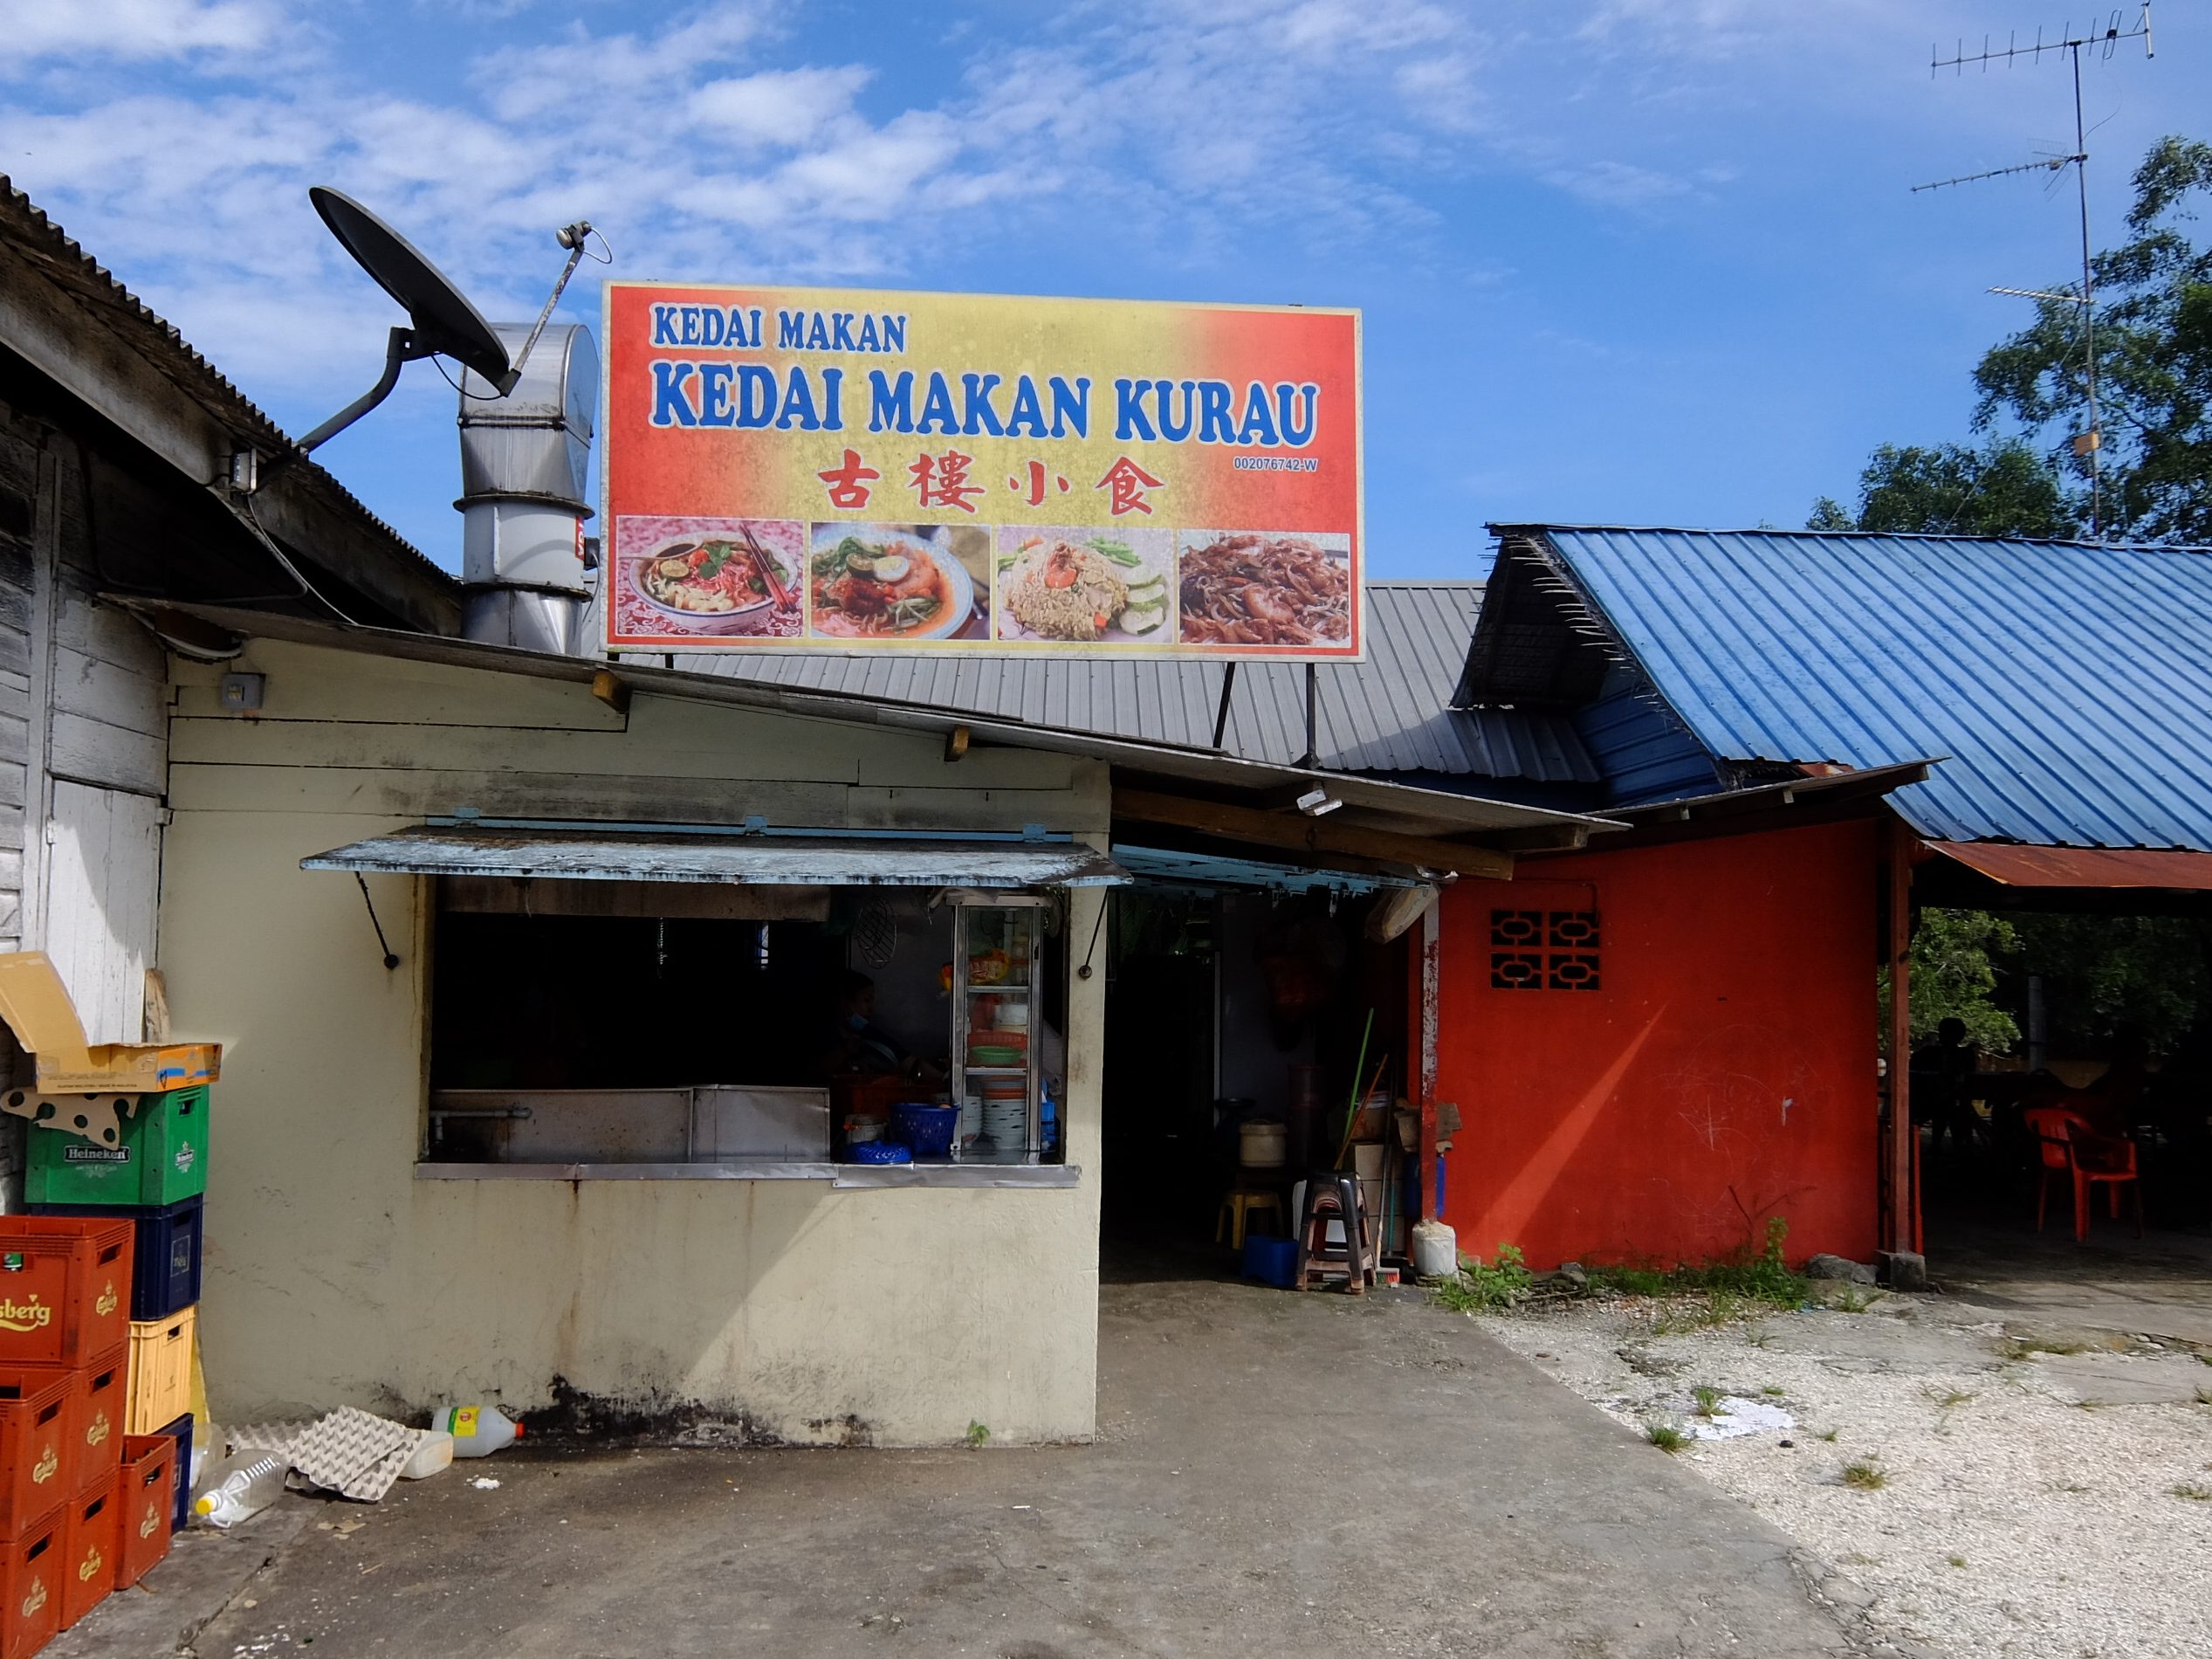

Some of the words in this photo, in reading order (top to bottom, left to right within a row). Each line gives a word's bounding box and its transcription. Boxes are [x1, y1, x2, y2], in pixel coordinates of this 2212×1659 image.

[654, 306, 762, 348] KEDAI
[778, 311, 904, 353] MAKAN
[652, 362, 844, 430] KEDAI
[868, 370, 1091, 438] MAKAN
[1114, 379, 1317, 446] KURAU
[818, 448, 1164, 516] 古樓小食
[1233, 457, 1317, 472] 002076742-W
[68, 1148, 127, 1160] Heineken
